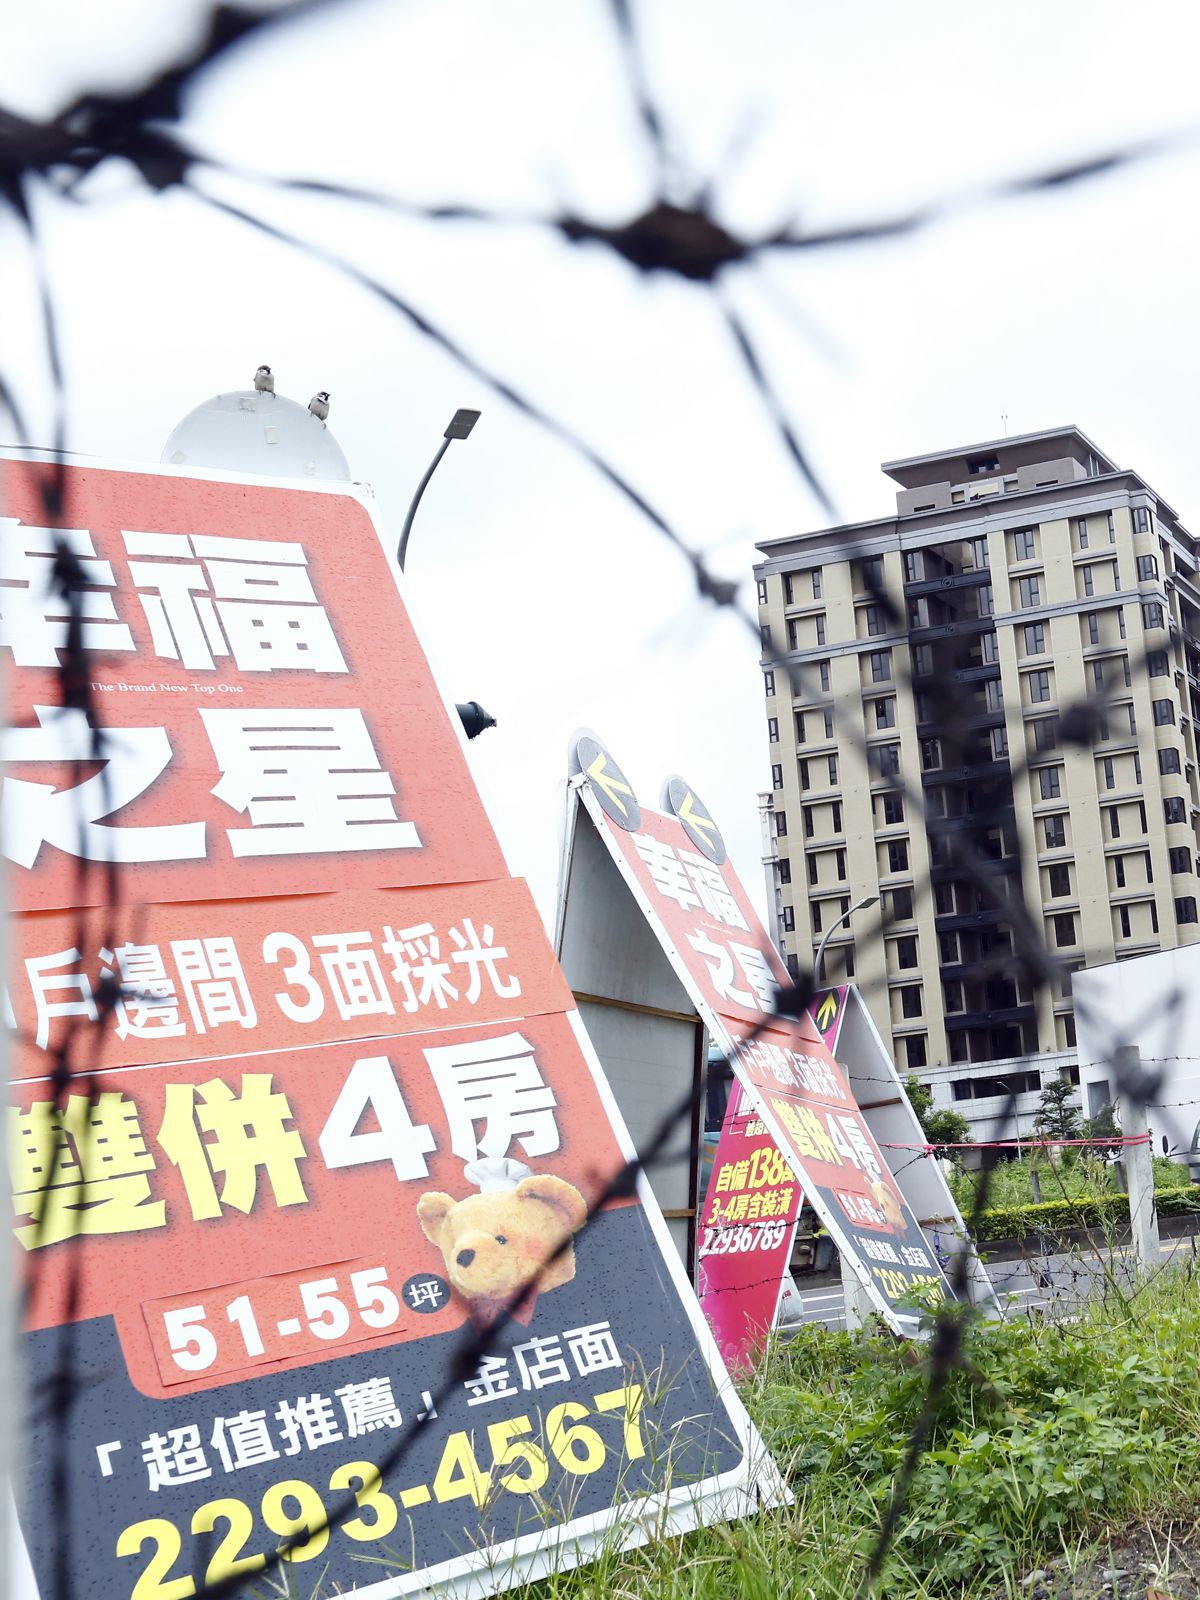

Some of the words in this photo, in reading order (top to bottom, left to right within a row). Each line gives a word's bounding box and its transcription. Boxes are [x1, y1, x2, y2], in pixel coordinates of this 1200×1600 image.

[90, 682, 114, 692] The
[117, 682, 157, 692] Brand
[159, 683, 188, 692] New
[191, 683, 215, 694] Top
[218, 683, 243, 693] One
[2, 705, 423, 870] 之星
[630, 832, 752, 932] 幸福
[262, 918, 521, 1024] 3面採光
[700, 1218, 787, 1256] 22936789
[707, 1187, 795, 1225] 3-4房含裝潢
[115, 1383, 650, 1600] 2293-4567
